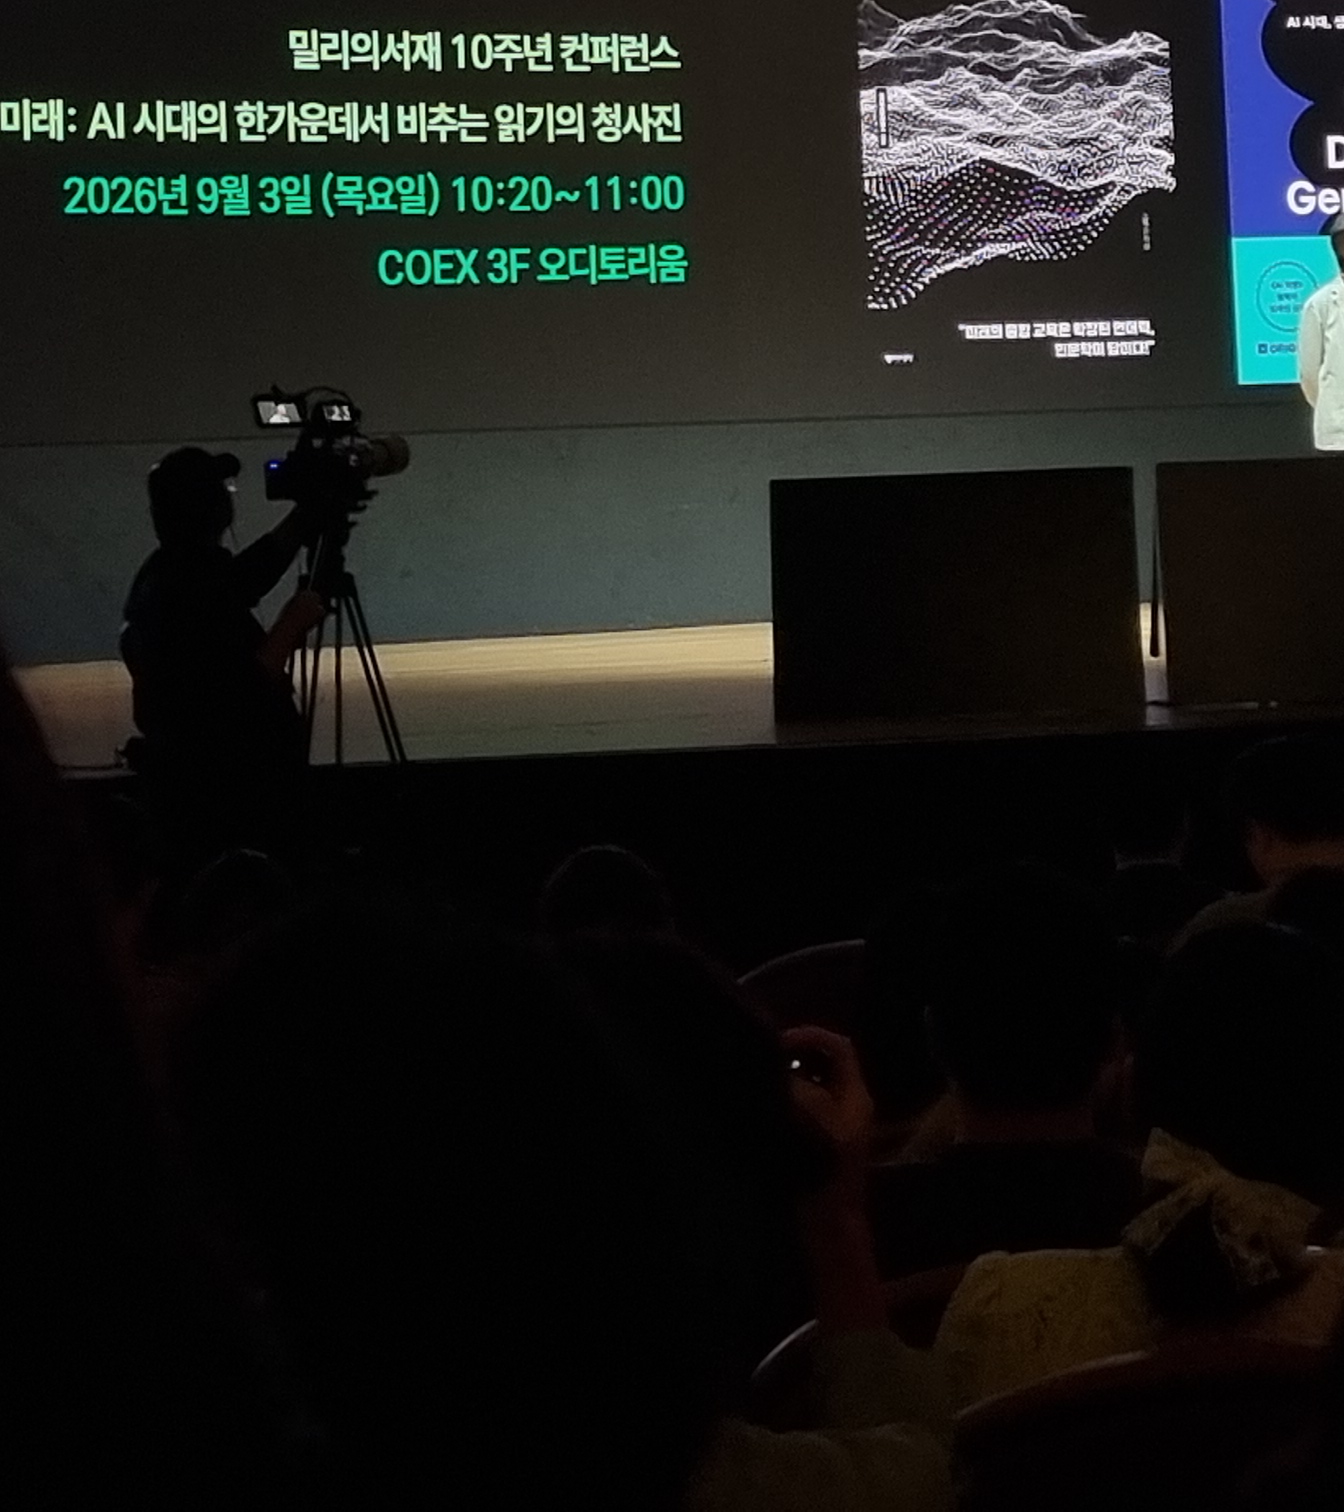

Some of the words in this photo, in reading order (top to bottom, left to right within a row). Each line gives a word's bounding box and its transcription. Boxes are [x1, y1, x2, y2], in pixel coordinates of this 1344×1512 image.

[1286, 16, 1301, 28] AI
[289, 29, 442, 71] 밀리의서재
[452, 33, 553, 71] 10주년
[560, 33, 681, 72] 컨퍼런스
[0, 99, 76, 141] 미래:
[87, 102, 125, 139] AI
[133, 100, 227, 142] 시대의
[234, 101, 389, 142] 한가운데서
[397, 102, 489, 142] 비추는
[495, 103, 584, 142] 읽기의
[592, 103, 682, 142] 청사진
[64, 175, 188, 214] 2026년
[197, 175, 250, 215] 9월
[259, 174, 312, 214] 3일
[322, 172, 439, 217] (목요일)
[452, 176, 684, 211] 10:20~11:00
[379, 249, 479, 285] COEX
[487, 248, 530, 283] 3F
[537, 244, 688, 284] 오디토리움
